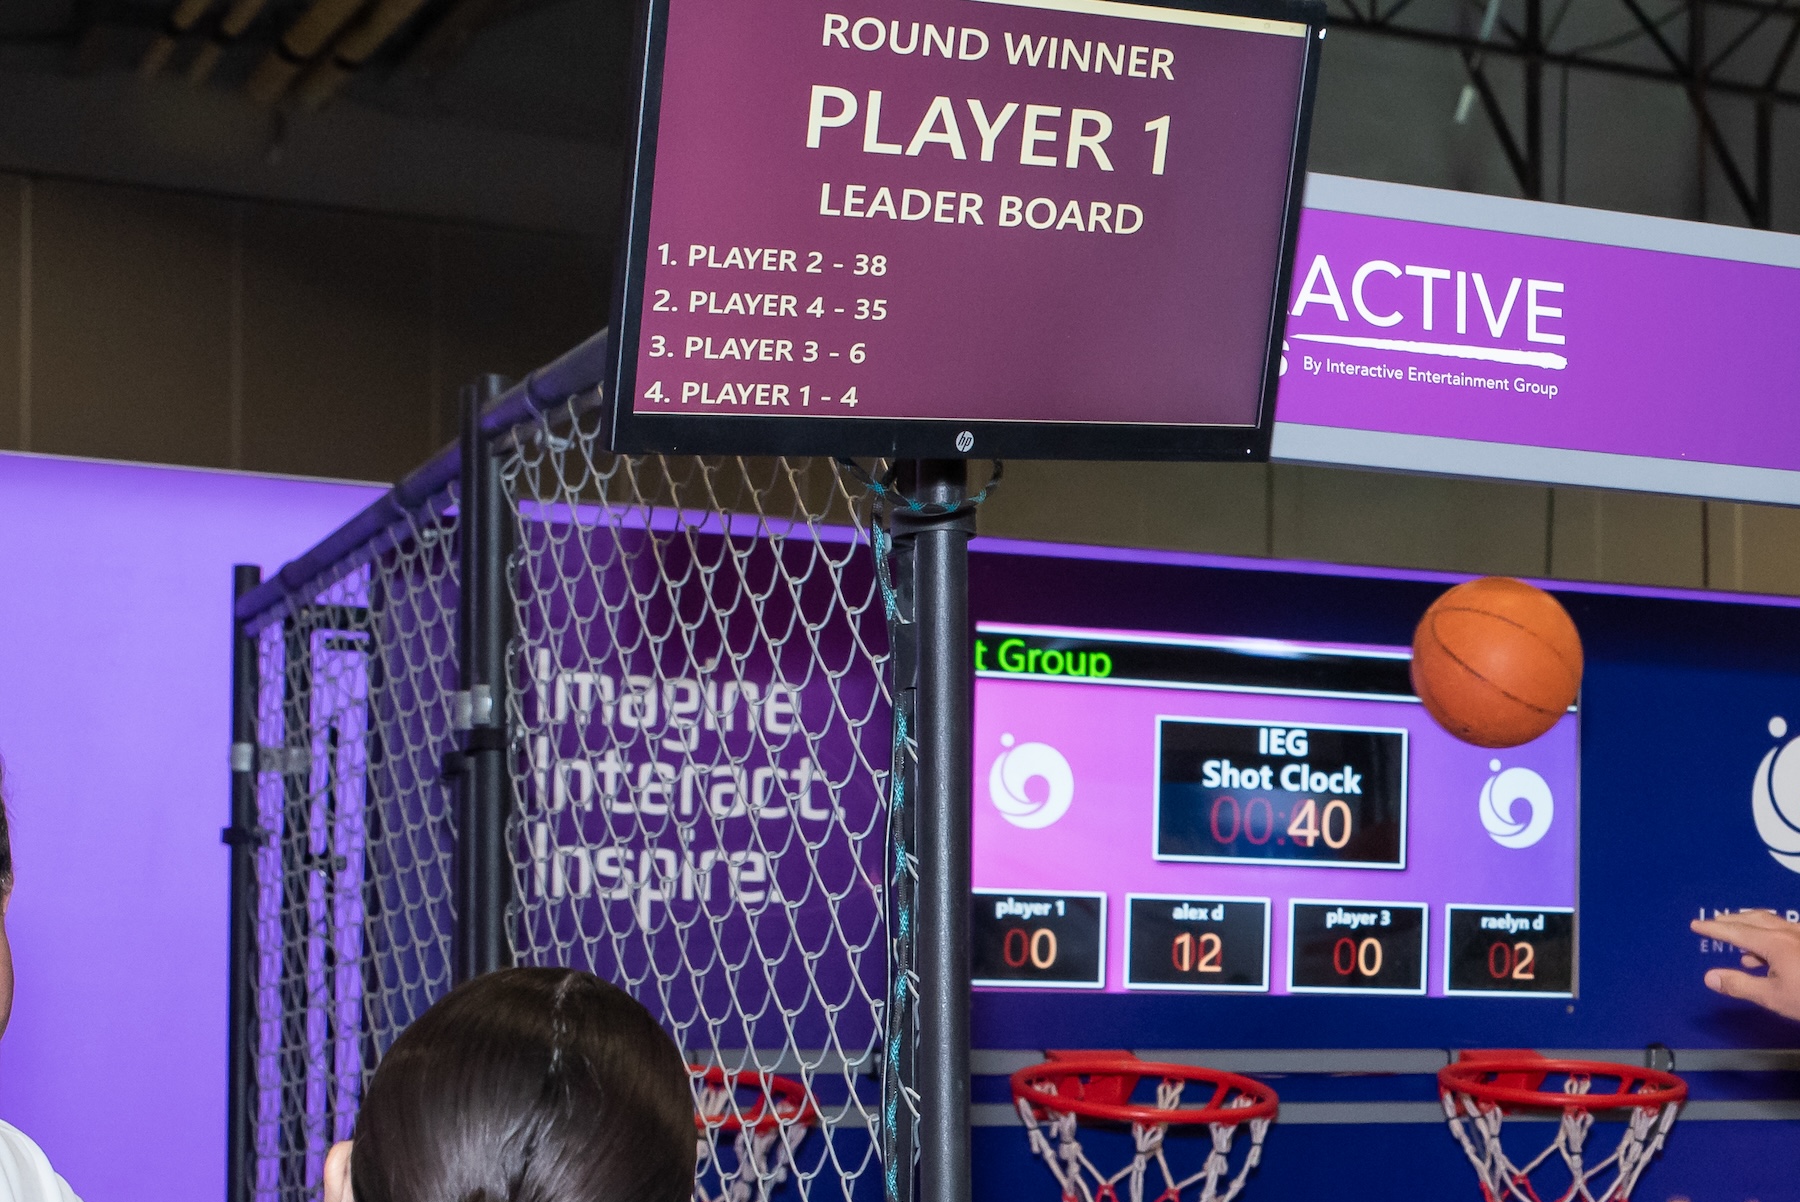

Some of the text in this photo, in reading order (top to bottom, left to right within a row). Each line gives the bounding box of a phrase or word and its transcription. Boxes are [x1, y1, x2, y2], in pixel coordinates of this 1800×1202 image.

[823, 14, 1174, 80] ROUND WINNER
[807, 85, 1170, 175] PLAYER 1
[820, 183, 1143, 234] LEADER BOARD
[658, 243, 677, 265] 1.
[689, 245, 797, 271] PLAYER
[806, 252, 822, 273] 2
[854, 254, 886, 276] 38
[653, 290, 677, 311] 2.
[690, 291, 797, 316] PLAYER
[807, 297, 824, 317] 4
[855, 299, 886, 320] 35
[1287, 254, 1566, 346] ACTIVE
[649, 336, 673, 357] 3.
[686, 337, 793, 361] PLAYER
[803, 341, 818, 362] 3
[850, 343, 865, 363] 6
[1304, 356, 1322, 375] By
[1327, 359, 1403, 379] Interactive
[1409, 367, 1509, 390] Entertainment
[1514, 378, 1558, 399] Group
[644, 381, 670, 402] 4.
[682, 382, 789, 405] PLAYER
[800, 386, 809, 406] 1
[840, 387, 858, 407] 4
[957, 431, 973, 451] hp
[998, 639, 1112, 678] Group
[1258, 727, 1309, 757] IEG
[1202, 759, 1362, 794] Shot Clock
[995, 897, 1065, 920] player 1
[1172, 903, 1224, 921] alex d
[1326, 907, 1391, 929] player 3
[1481, 913, 1544, 933] raelyn d
[1172, 932, 1222, 973] 12
